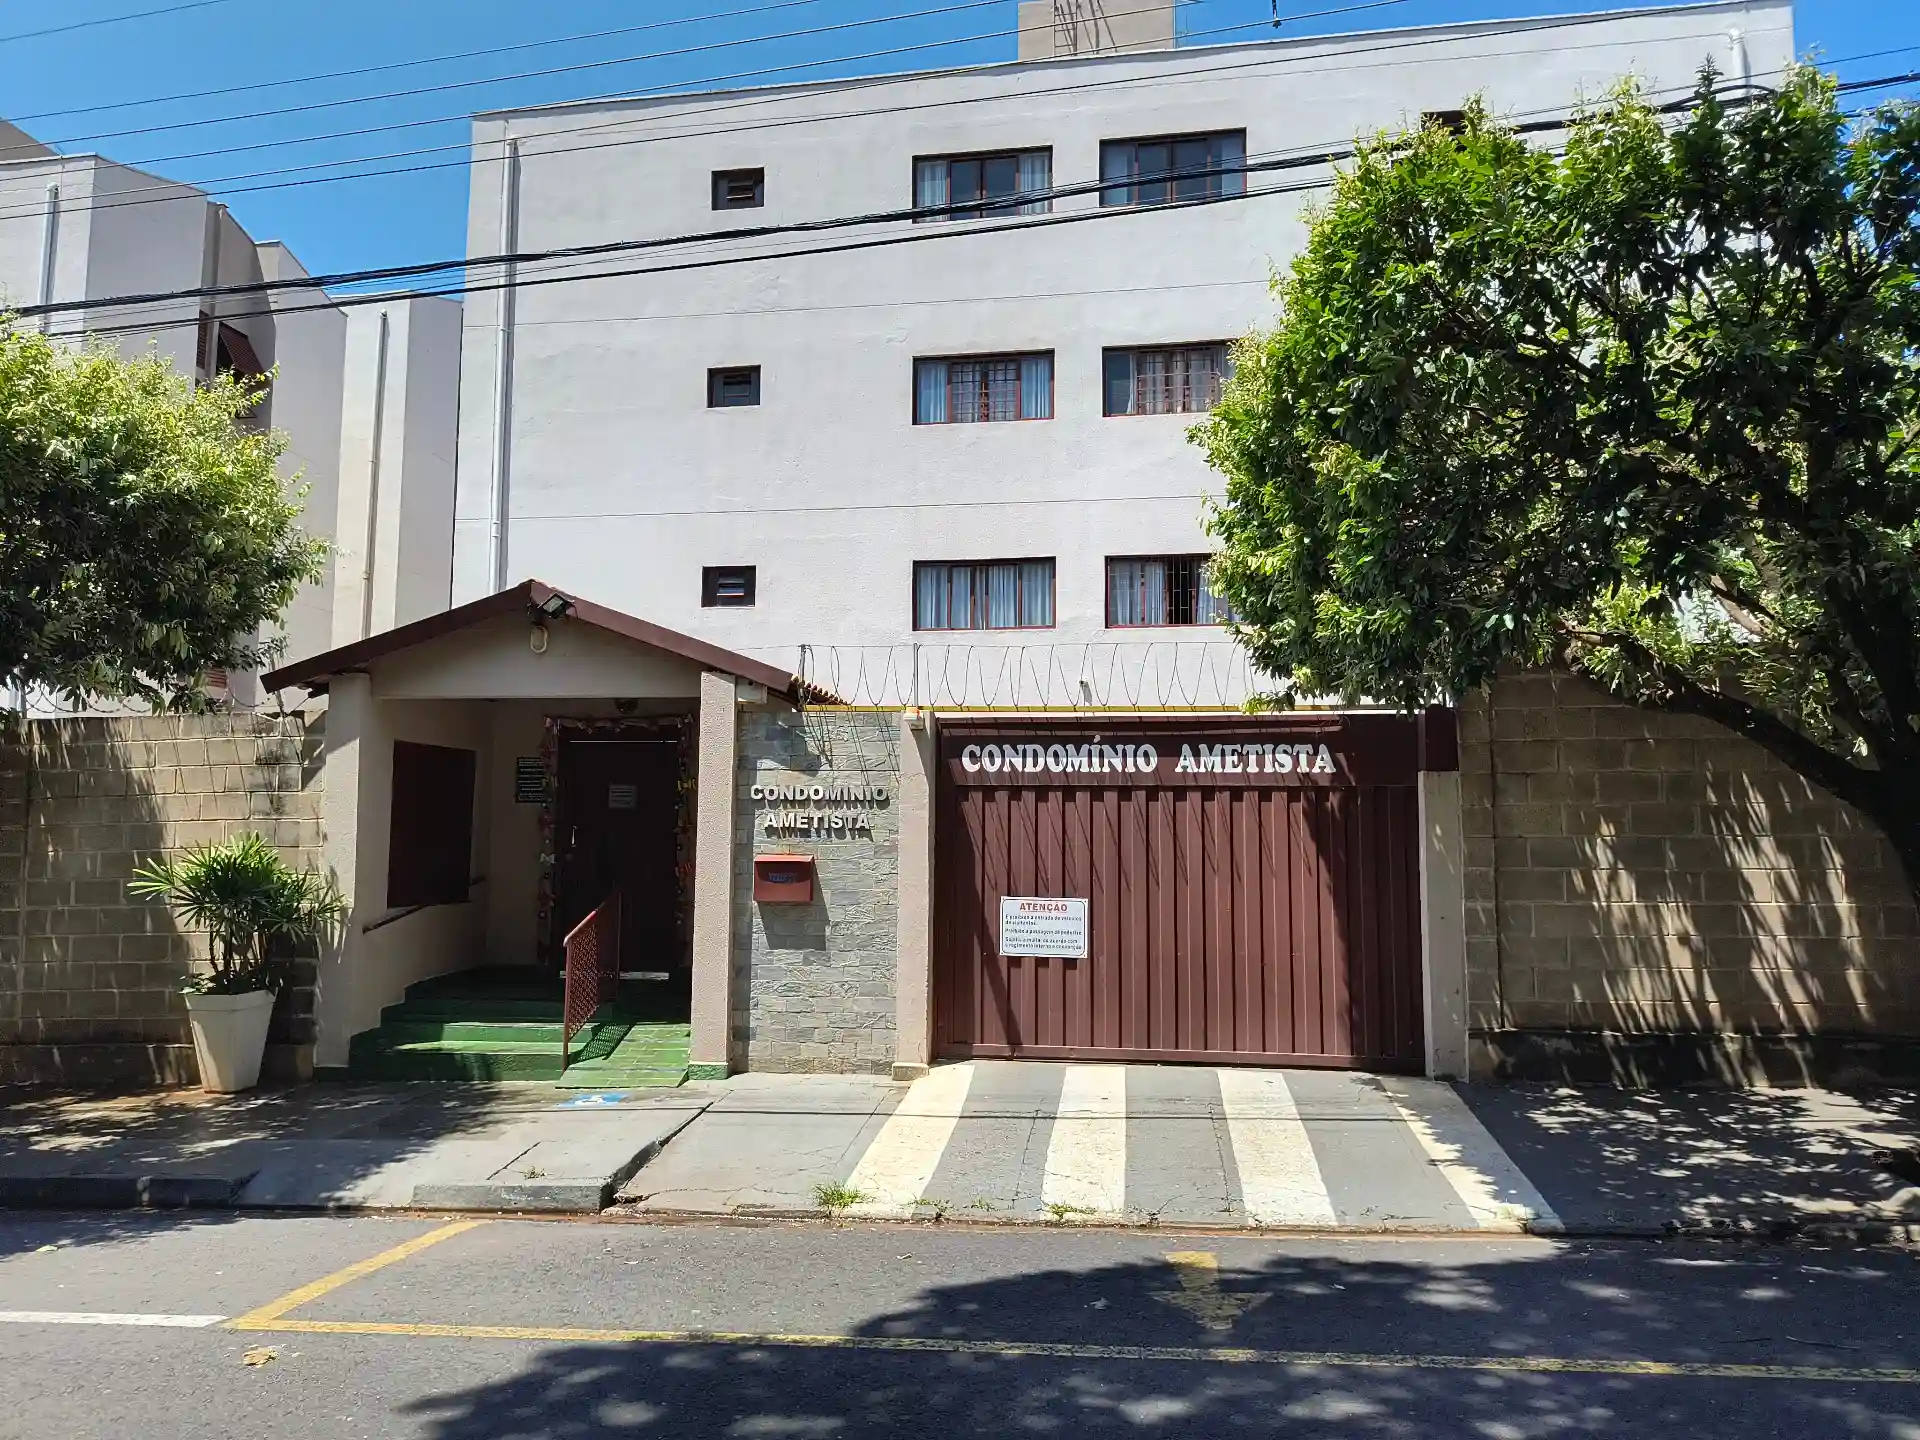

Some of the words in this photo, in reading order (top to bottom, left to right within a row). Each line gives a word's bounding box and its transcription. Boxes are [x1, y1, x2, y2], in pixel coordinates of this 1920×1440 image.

[961, 734, 1158, 774] CONDOMÍNIO
[1174, 742, 1336, 774] AMETISTA
[763, 811, 870, 829] AMETISTA
[1019, 902, 1068, 913] ATENÇÃO
